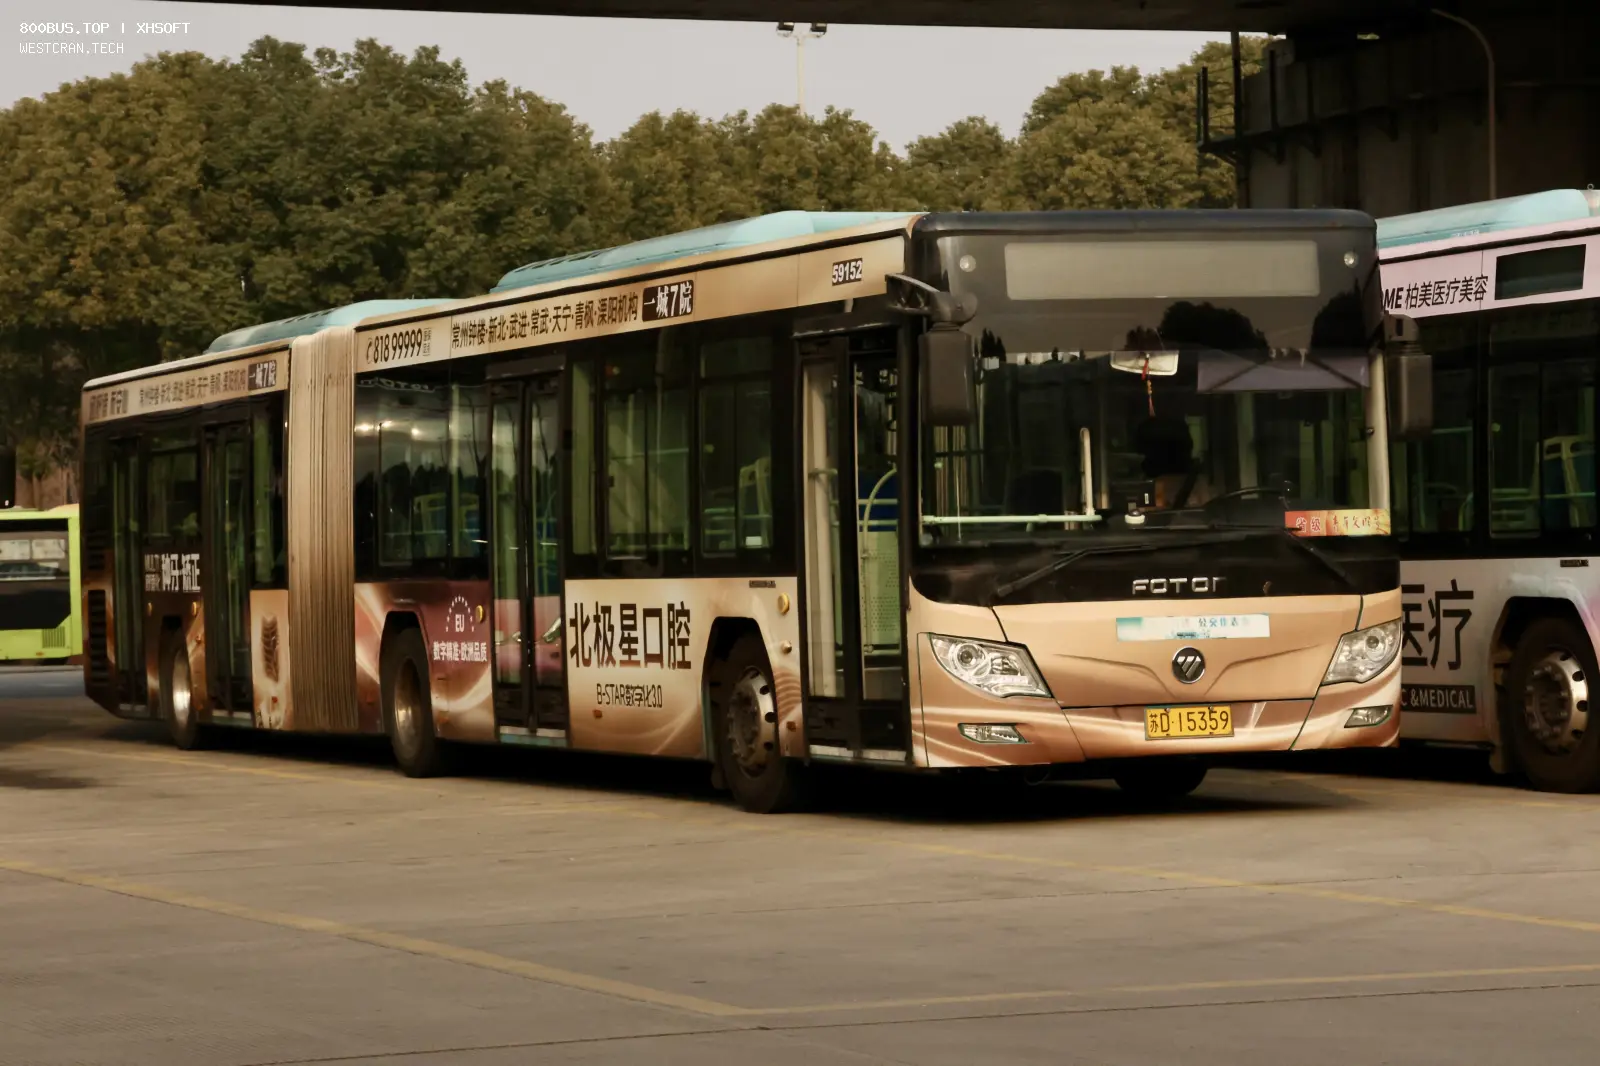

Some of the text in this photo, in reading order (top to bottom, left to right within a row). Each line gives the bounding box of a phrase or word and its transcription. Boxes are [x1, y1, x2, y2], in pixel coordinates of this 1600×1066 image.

[832, 260, 863, 283] 59152
[1382, 287, 1404, 309] ME
[1404, 274, 1489, 310] 柏美医疗美容
[455, 614, 465, 632] EU
[569, 601, 692, 670] 北极星口腔
